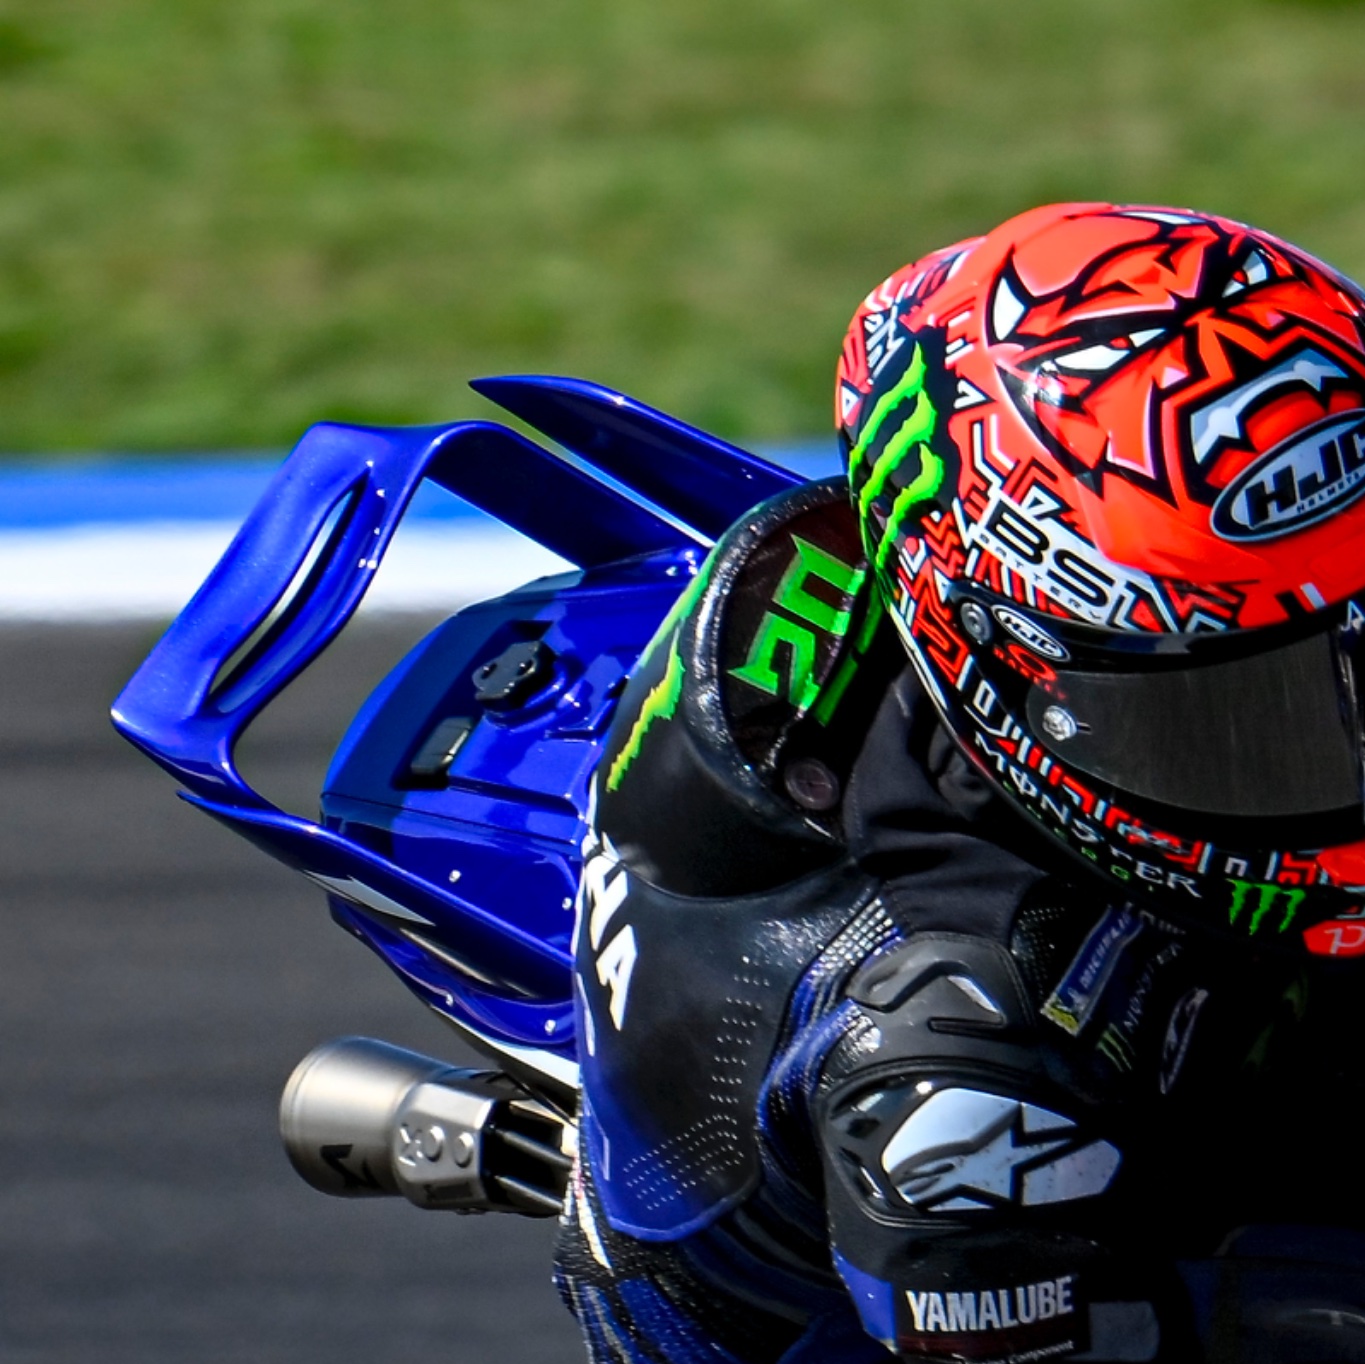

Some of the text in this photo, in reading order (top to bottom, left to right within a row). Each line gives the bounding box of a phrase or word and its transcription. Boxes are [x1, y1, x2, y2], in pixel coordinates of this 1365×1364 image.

[979, 531, 1105, 620] BATTERY
[1003, 613, 1059, 657] HJC
[975, 730, 1203, 899] MONSTER
[904, 1274, 1076, 1333] YAMALUBE
